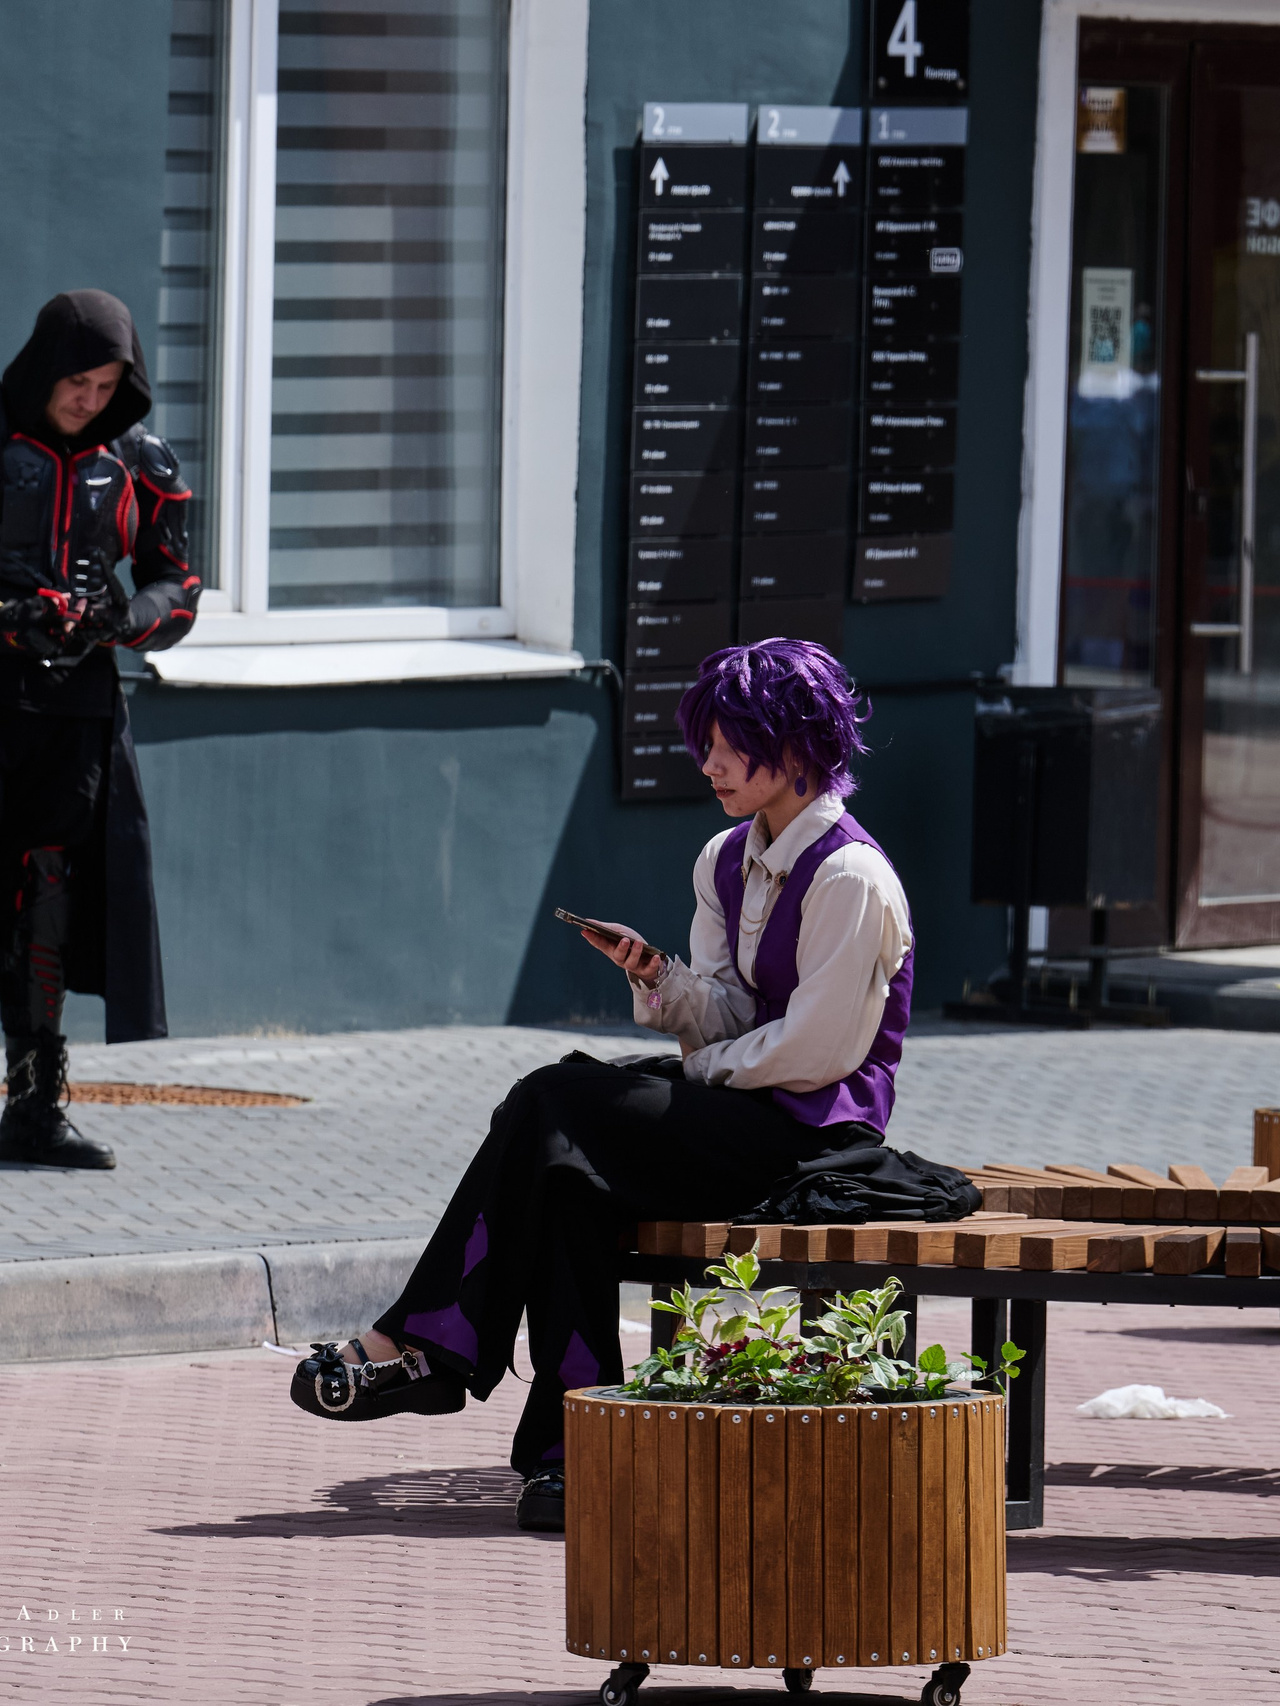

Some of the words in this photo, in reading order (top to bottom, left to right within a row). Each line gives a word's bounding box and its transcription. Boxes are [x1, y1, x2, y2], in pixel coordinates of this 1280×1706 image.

[887, 0, 923, 77] 4
[652, 106, 665, 135] 2
[767, 109, 780, 138] 2
[878, 112, 889, 140] 1
